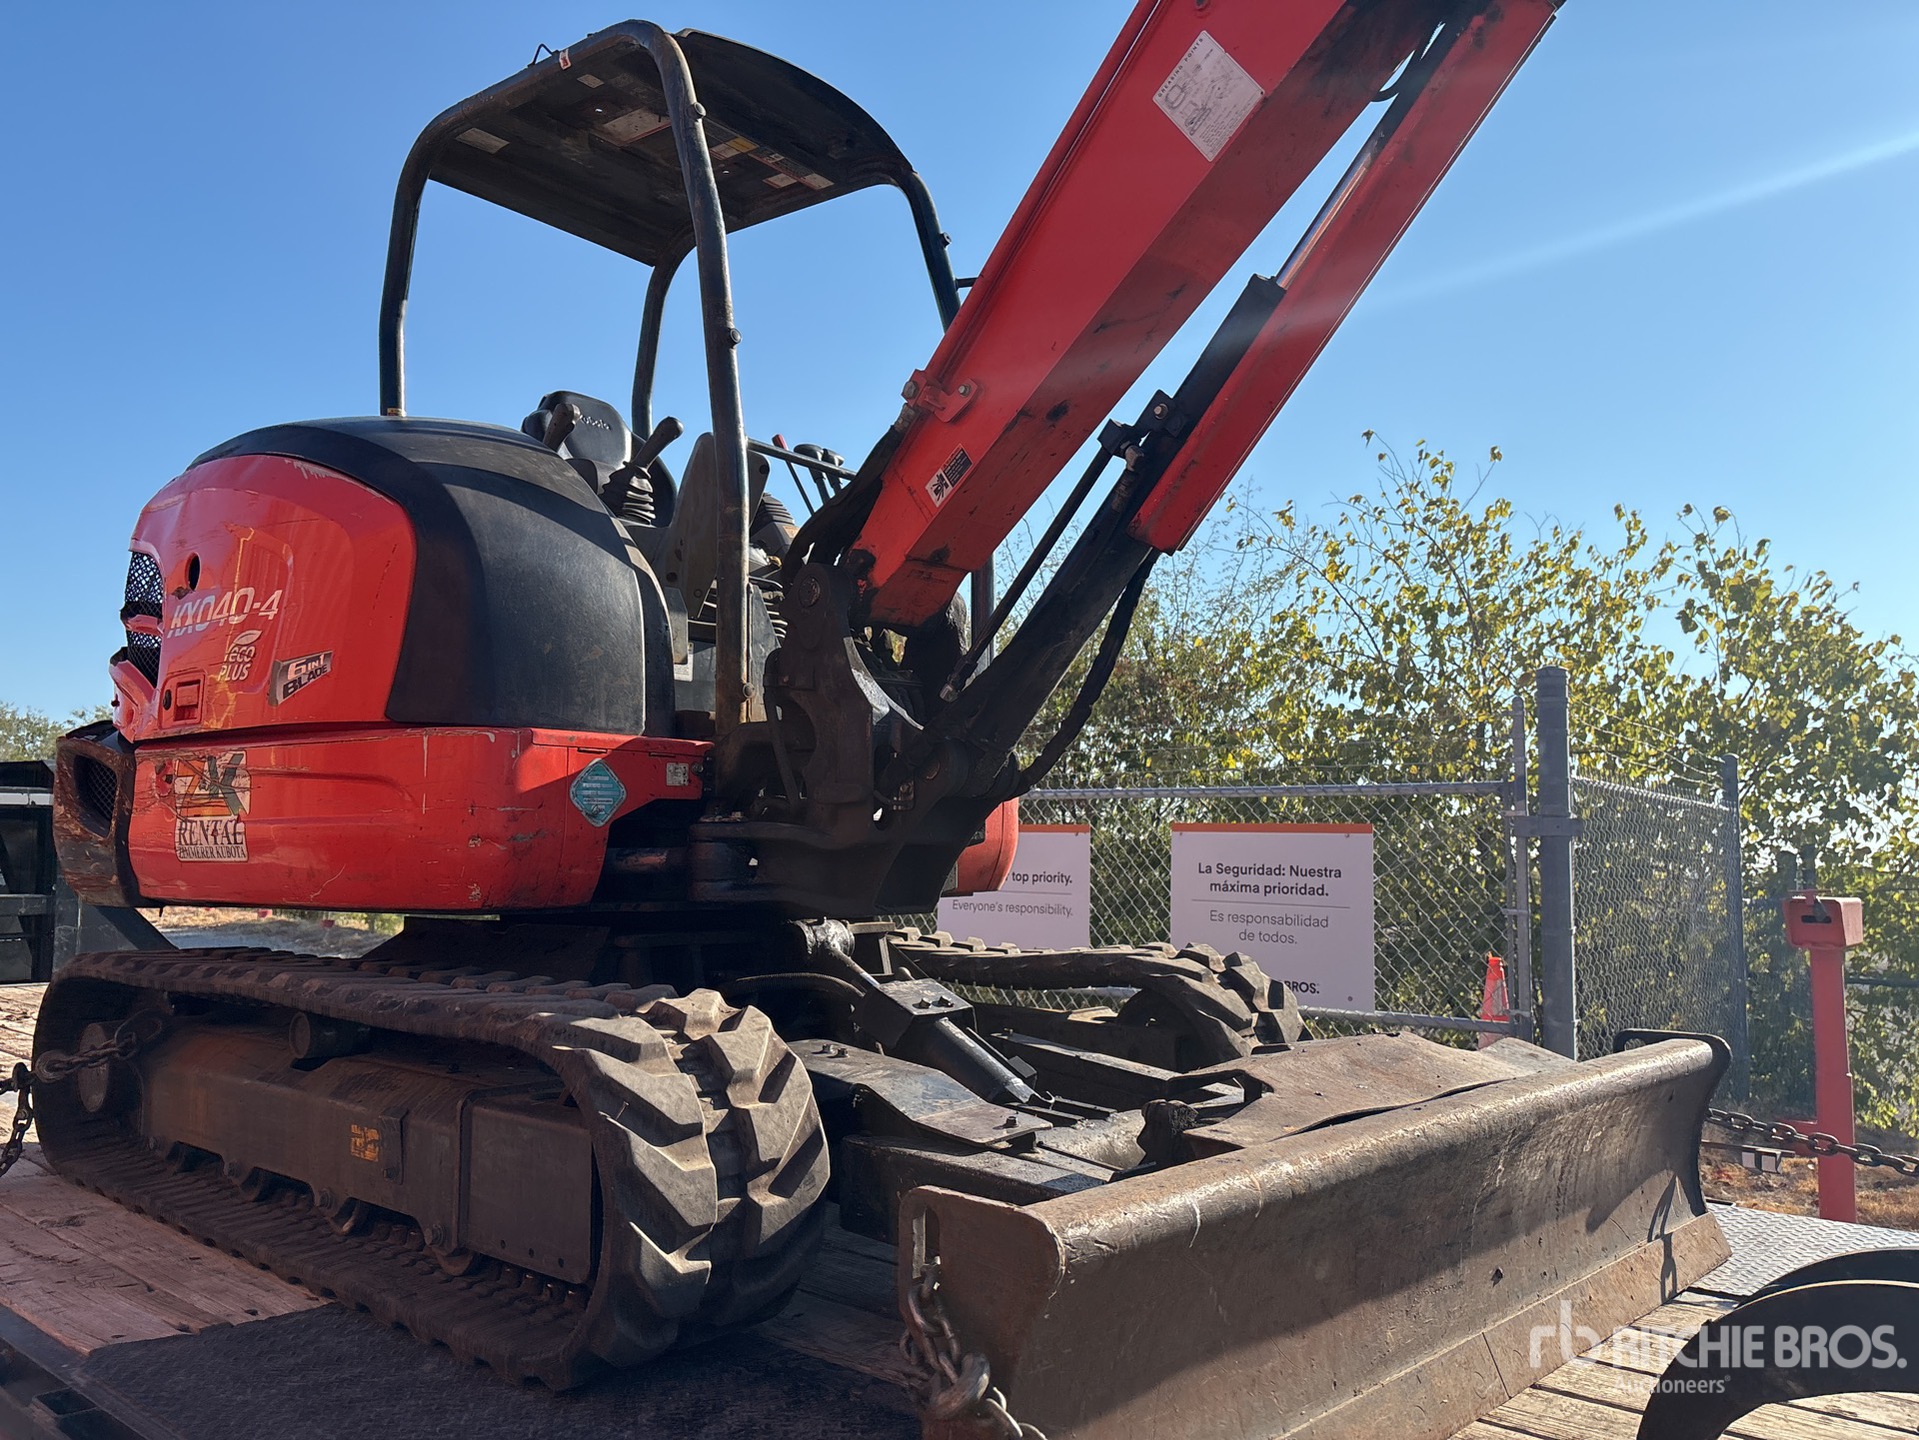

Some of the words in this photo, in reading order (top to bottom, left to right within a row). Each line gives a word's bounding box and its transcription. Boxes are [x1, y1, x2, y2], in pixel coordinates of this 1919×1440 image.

[217, 663, 251, 682] PLUS
[282, 664, 328, 700] BLADE
[178, 819, 244, 846] RENTAL
[216, 846, 247, 859] KUBOTA
[1011, 872, 1030, 884] top
[1031, 871, 1074, 886] priority.
[1198, 862, 1213, 875] La
[1215, 862, 1287, 879] Seguridad:
[1289, 865, 1343, 879] Nuestra
[1209, 880, 1261, 895] máxima
[1263, 882, 1330, 898] prioridad.
[1005, 902, 1074, 917] responsibility.
[1209, 910, 1225, 922] Es
[1227, 912, 1330, 929] responsabilidad
[1238, 929, 1256, 942] de
[1258, 931, 1299, 945] todos.
